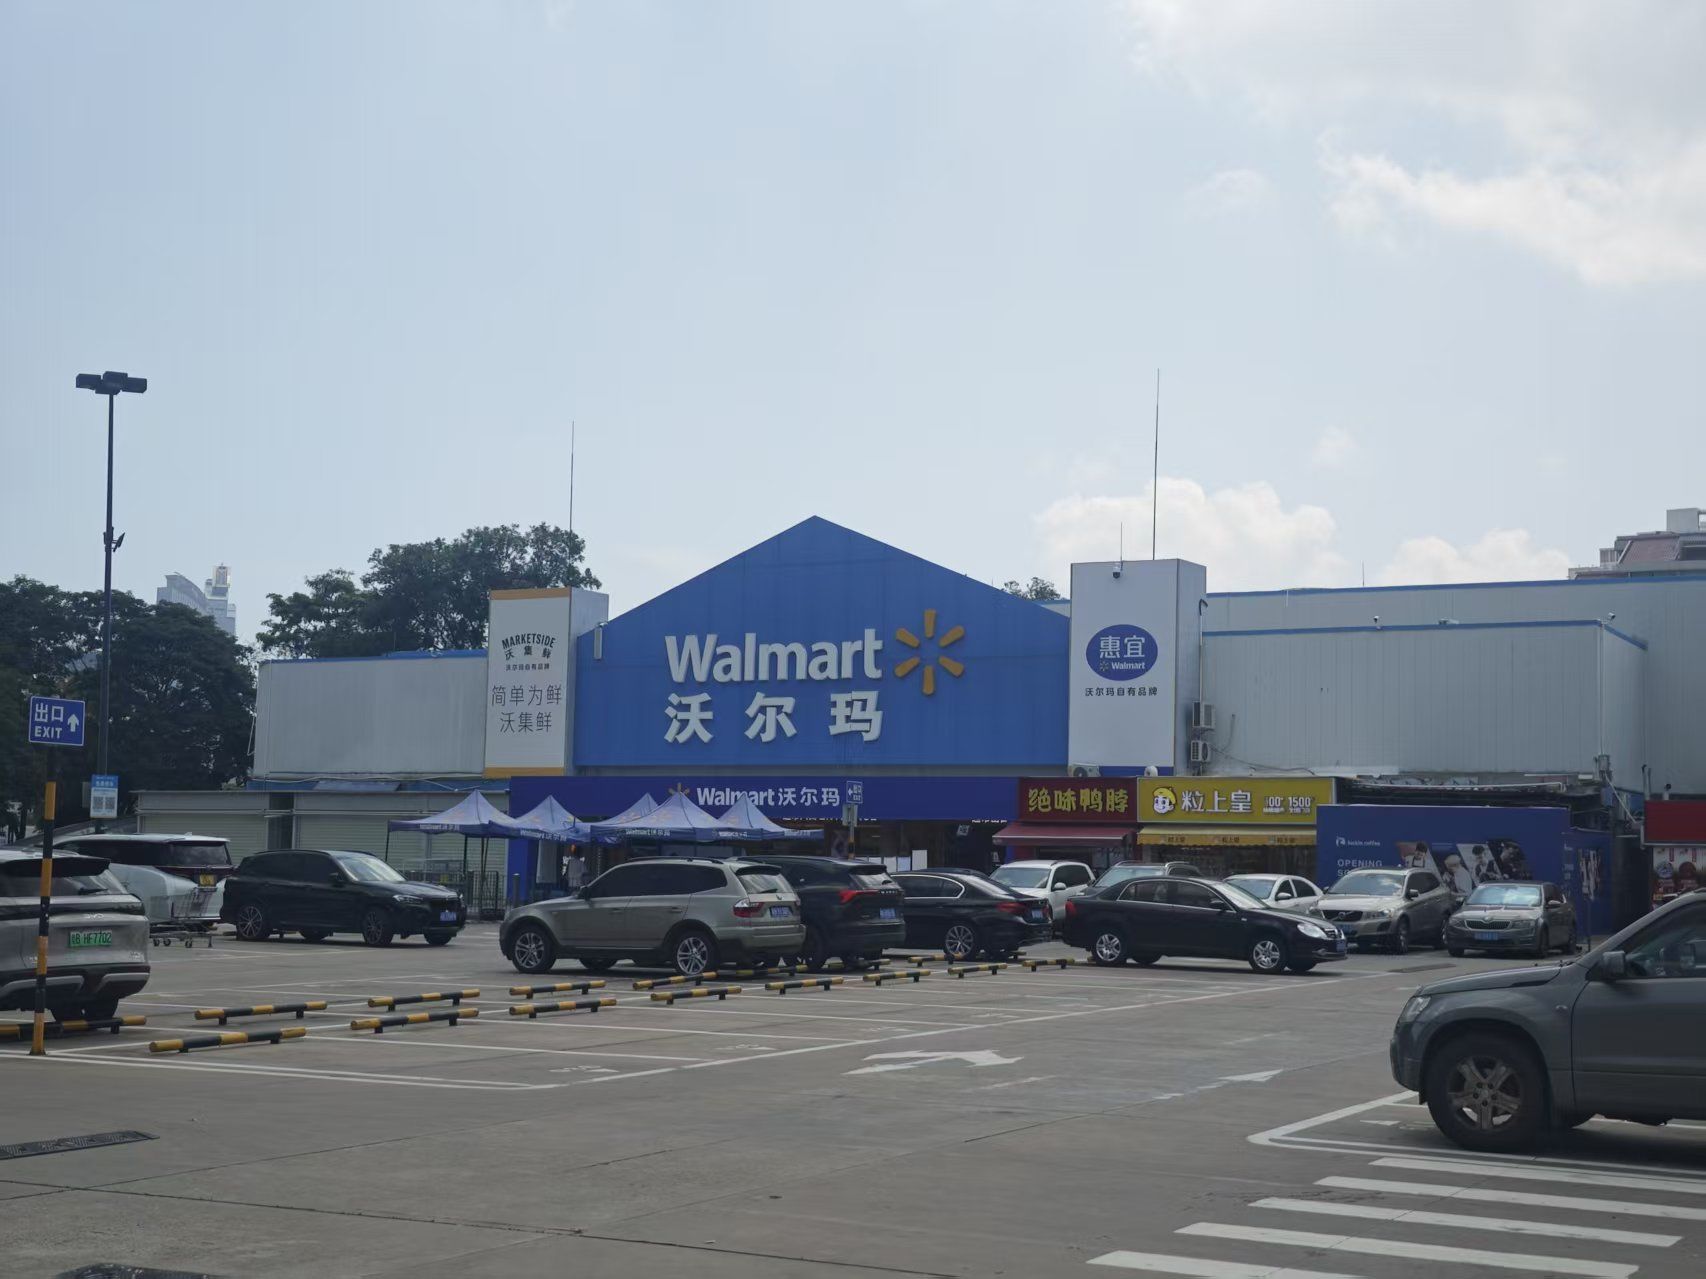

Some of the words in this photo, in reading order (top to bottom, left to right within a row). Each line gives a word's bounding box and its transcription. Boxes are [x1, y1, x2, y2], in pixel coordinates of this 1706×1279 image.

[501, 633, 556, 649] MARKETSIDE
[1099, 634, 1146, 659] 惠宜
[504, 645, 552, 660] 沃集鲜
[664, 628, 883, 683] Walmart
[1111, 661, 1146, 670] Walmart
[491, 684, 562, 707] 简单为鲜
[1085, 686, 1158, 697] 沃尔玛自有品牌
[34, 702, 64, 722] 出口
[500, 711, 552, 733] 沃集鲜
[664, 691, 883, 743] 沃尔玛
[34, 725, 63, 739] EXIT
[696, 787, 775, 806] Walmart
[778, 787, 840, 807] 沃尔玛
[1028, 787, 1129, 813] 绝味鸭脖
[1181, 789, 1252, 814] 粒上皇
[1287, 796, 1311, 807] 1500
[1337, 858, 1383, 868] OPENING
